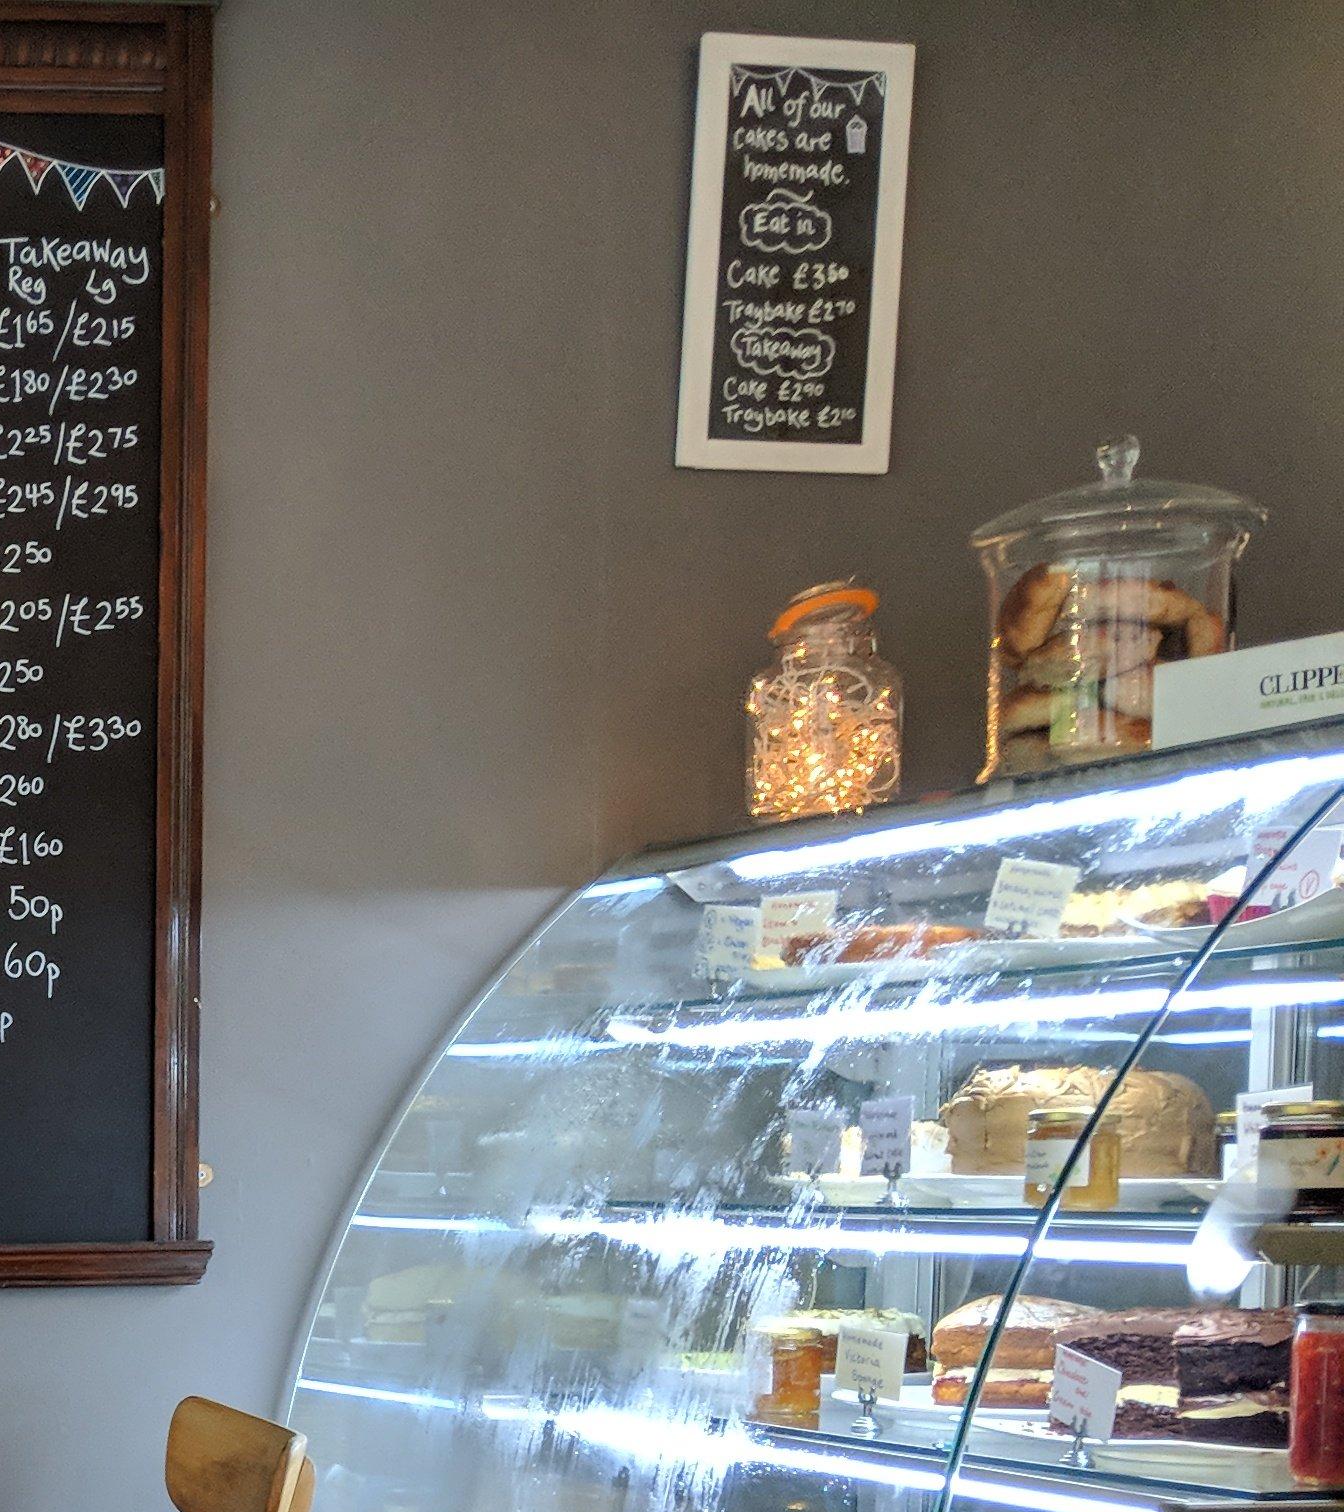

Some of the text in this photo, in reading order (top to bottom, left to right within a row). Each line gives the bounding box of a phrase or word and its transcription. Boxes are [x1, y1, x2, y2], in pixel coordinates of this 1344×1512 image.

[795, 131, 832, 152] are
[753, 214, 789, 235] Eat
[7, 264, 117, 306] Reg Lg
[726, 258, 781, 290] Cake
[741, 335, 822, 371] Takeaway
[7, 884, 64, 935] 50p
[3, 941, 61, 999] 60p
